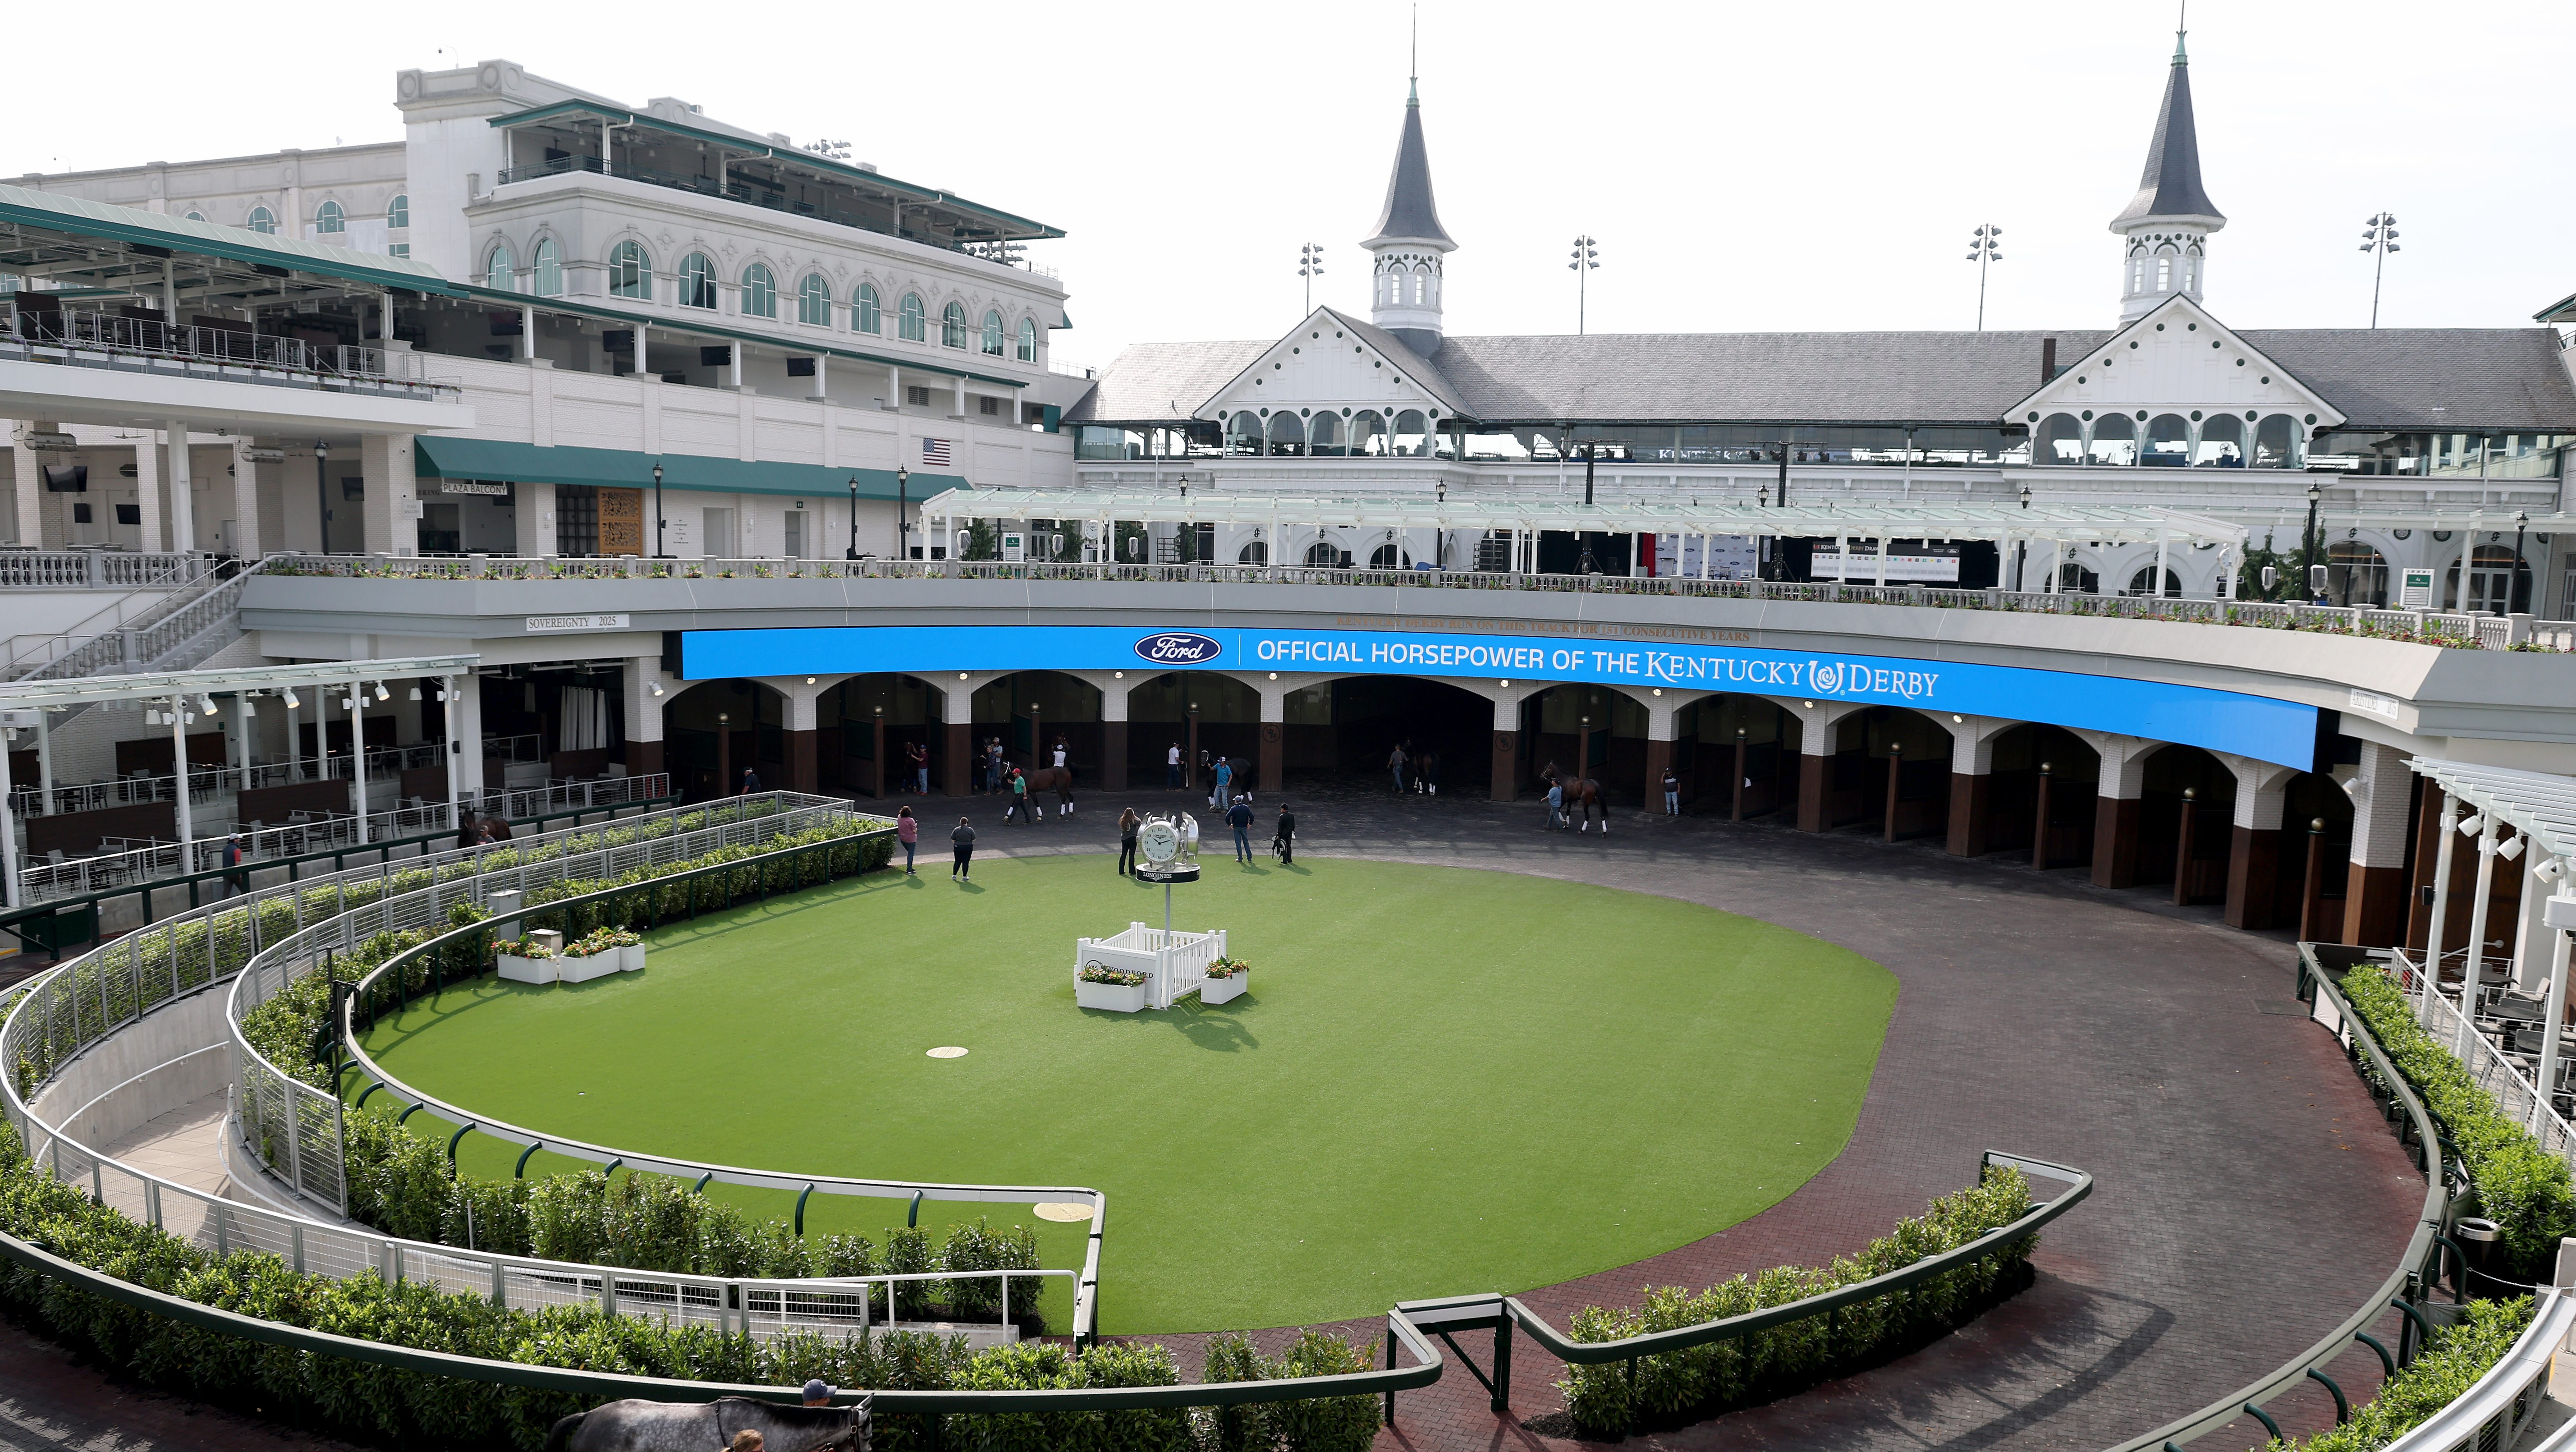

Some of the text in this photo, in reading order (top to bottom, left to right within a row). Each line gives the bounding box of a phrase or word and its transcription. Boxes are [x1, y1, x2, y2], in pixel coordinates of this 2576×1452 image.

[444, 484, 506, 494] PLAZA BALCONY
[529, 616, 616, 629] SOVEREIGNTY 2025
[1337, 616, 1750, 641] KENTUCKY DERBY RUN ON THIS TRACK FOR 151 CONSECUTIVE YEARS
[1152, 637, 1204, 658] Ford
[1258, 640, 1639, 674] OFFICIAL HORSEPOWER OF THE
[1645, 652, 1939, 699] KENTUCKY DERBY
[2352, 692, 2378, 710] ARISTIDES
[1108, 966, 1154, 978] WOODFORD
